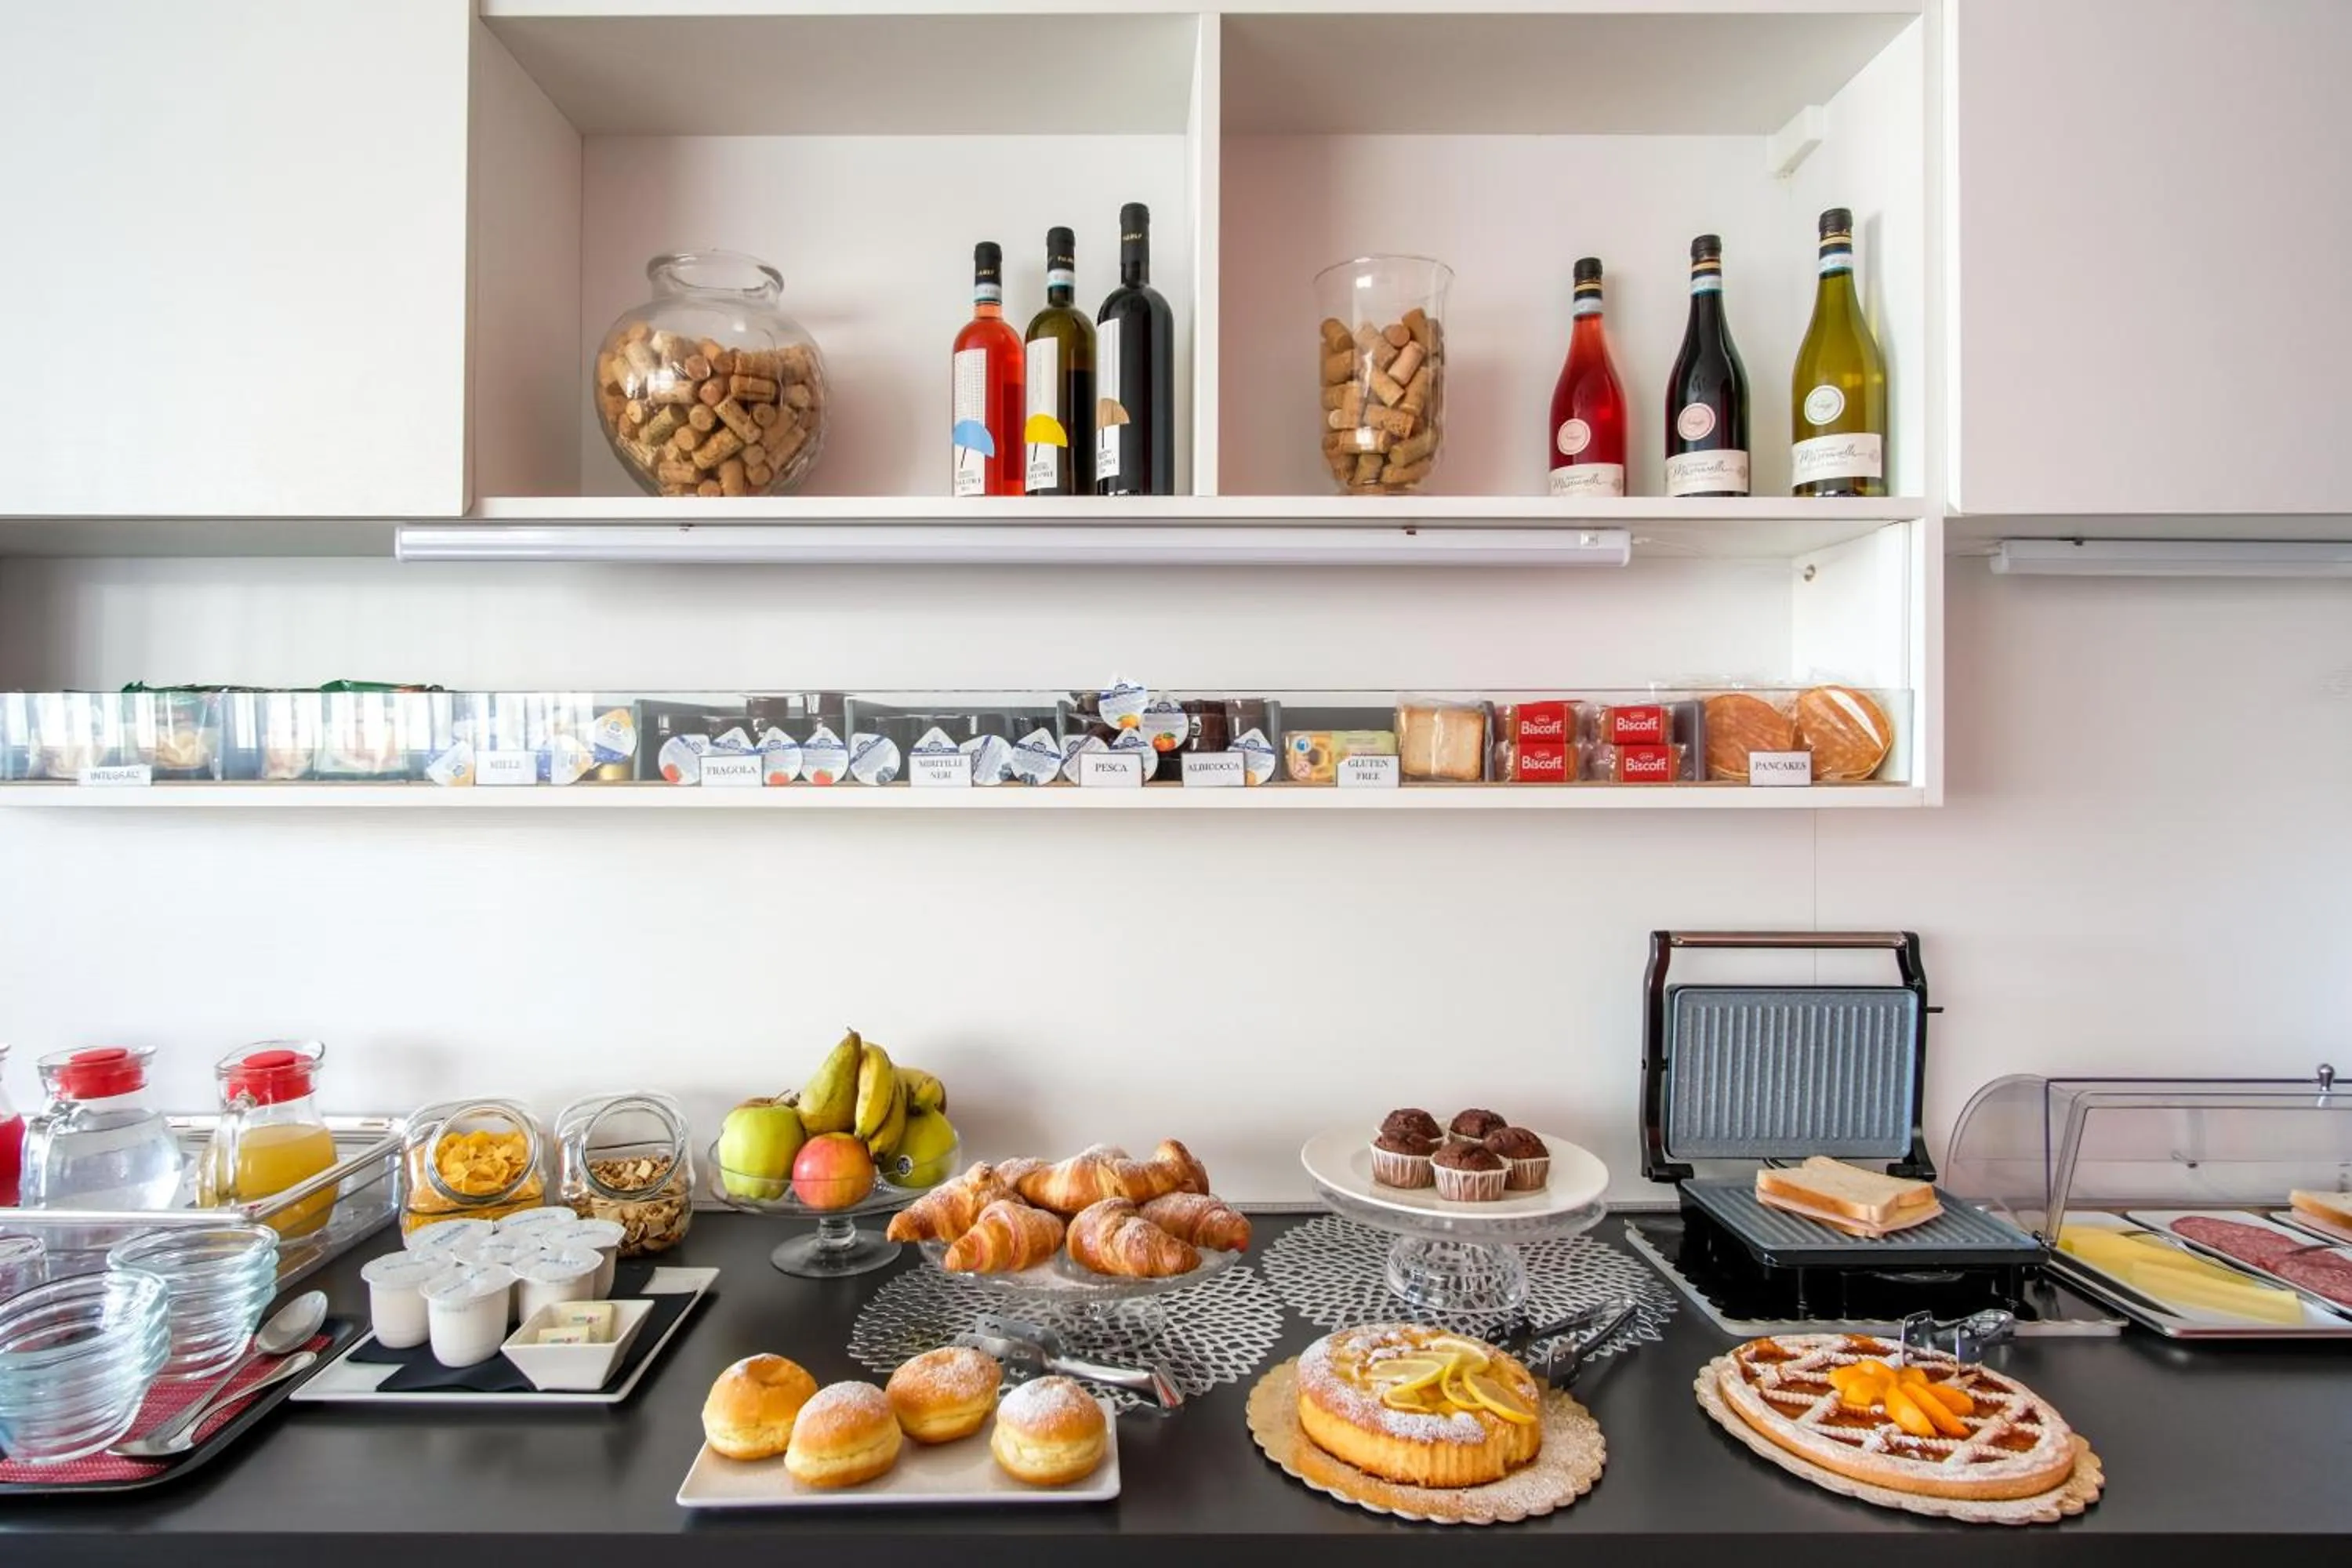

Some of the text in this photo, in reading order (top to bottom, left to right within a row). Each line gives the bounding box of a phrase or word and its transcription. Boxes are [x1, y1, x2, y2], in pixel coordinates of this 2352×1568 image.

[1521, 720, 1563, 735] Biscoff
[1617, 717, 1658, 731] Biscoff
[1094, 762, 1129, 773] PESCA
[1187, 761, 1240, 772] ALBICOCCA
[1347, 758, 1389, 768] GLUTEN
[1522, 755, 1563, 770] Biscoff
[1625, 757, 1666, 772] Biscoff
[1755, 760, 1807, 771] PANCAKES
[706, 765, 757, 775] FRAGOLA
[1356, 771, 1381, 781] FREE
